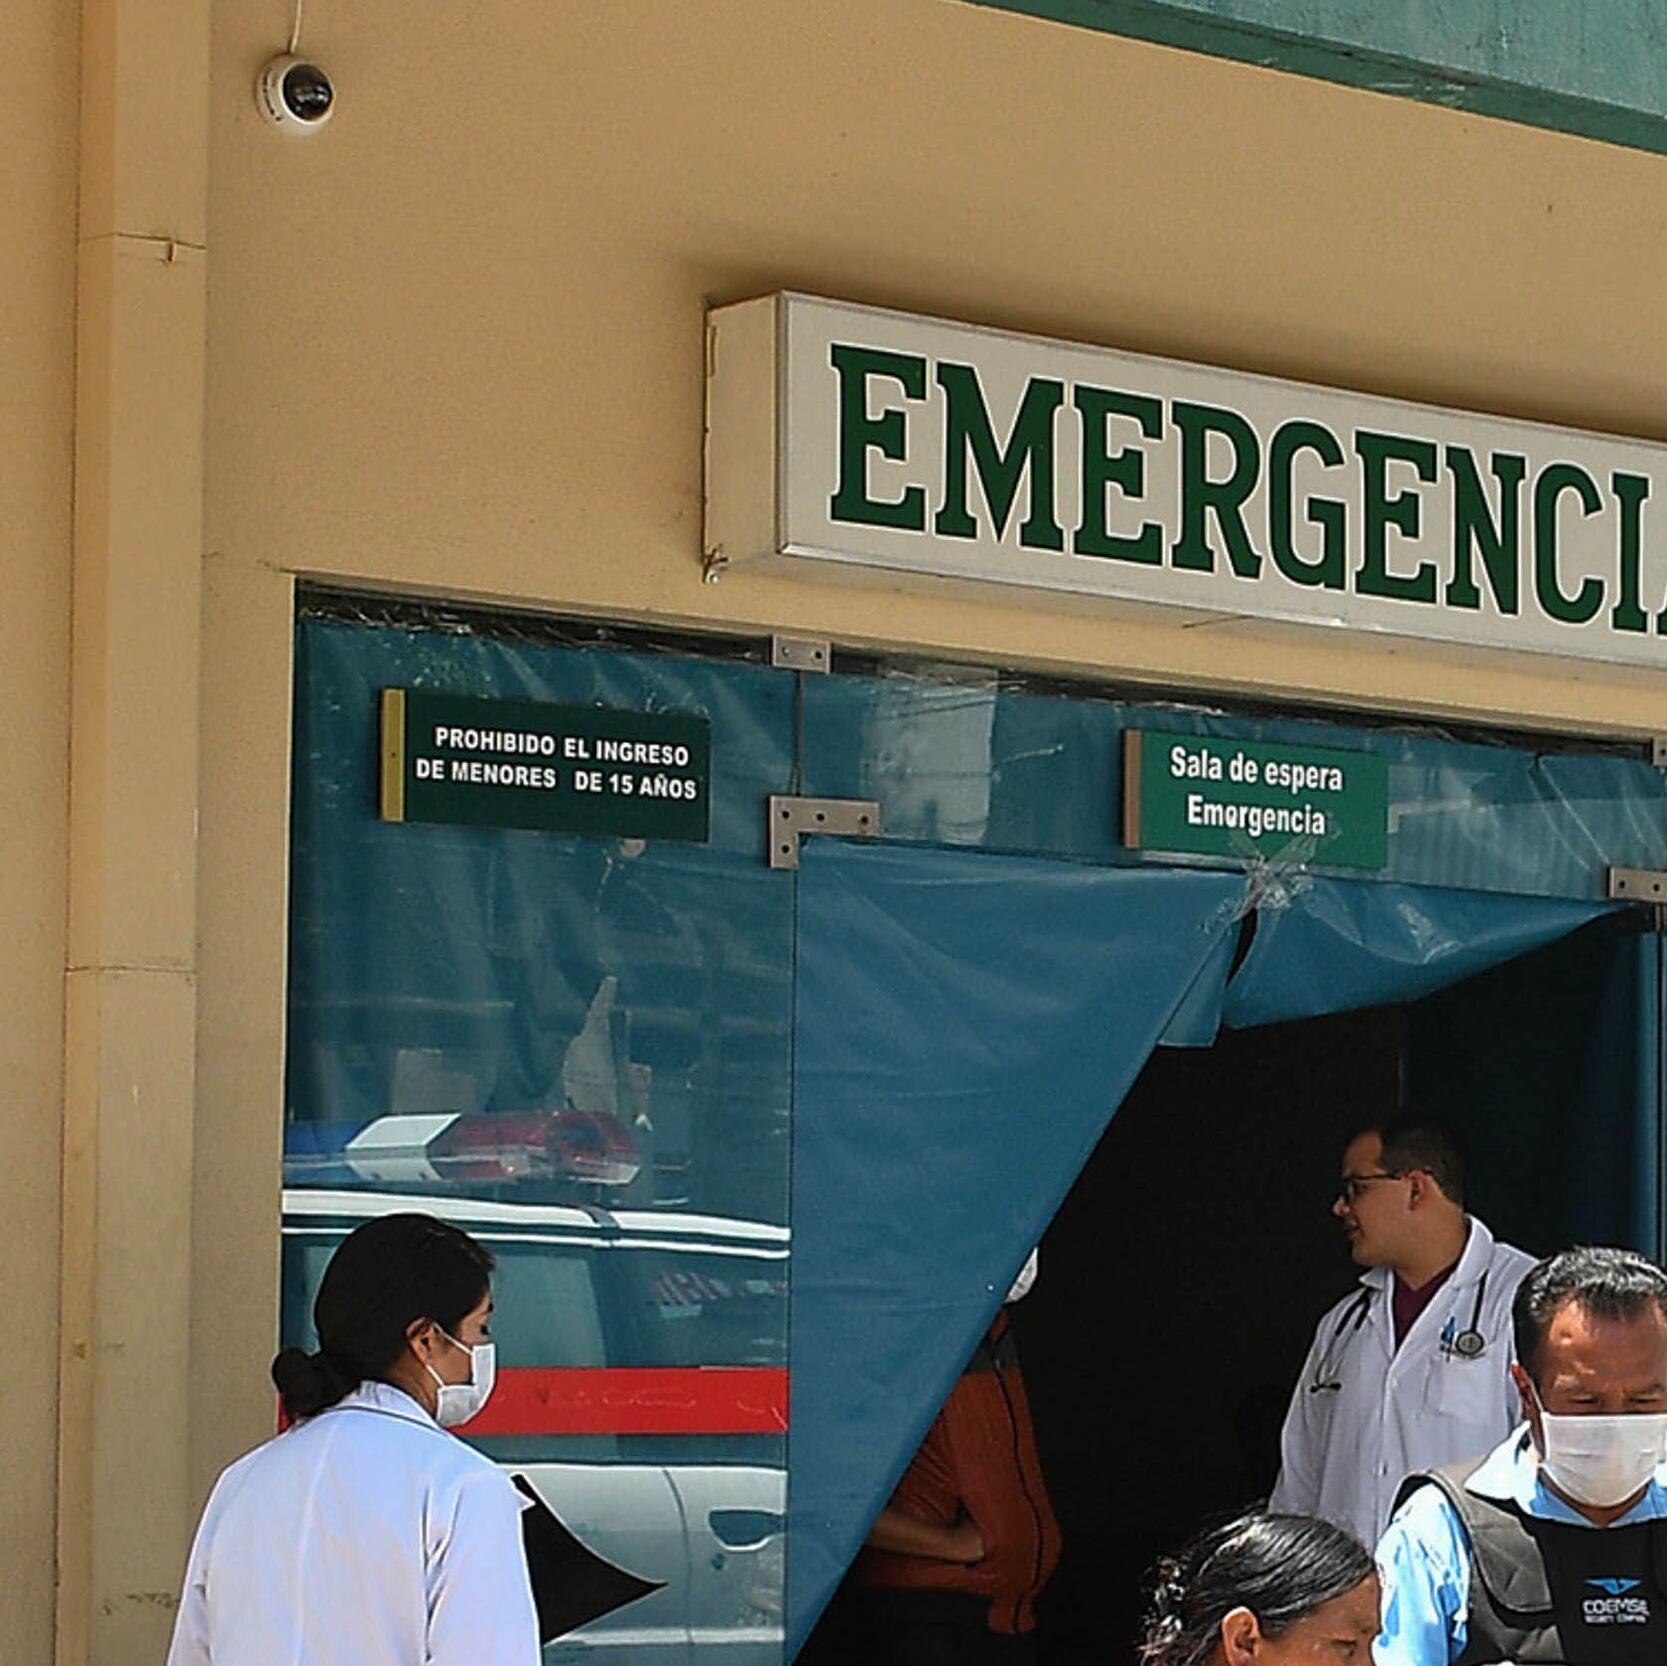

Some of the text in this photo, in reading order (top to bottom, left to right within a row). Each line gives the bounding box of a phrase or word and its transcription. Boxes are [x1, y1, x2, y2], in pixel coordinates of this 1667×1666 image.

[435, 726, 689, 766] PROHIBIDO EL INGRESO
[416, 758, 697, 799] DE MENORES DE 15 AÑOS
[1170, 746, 1343, 794] Sala de espera
